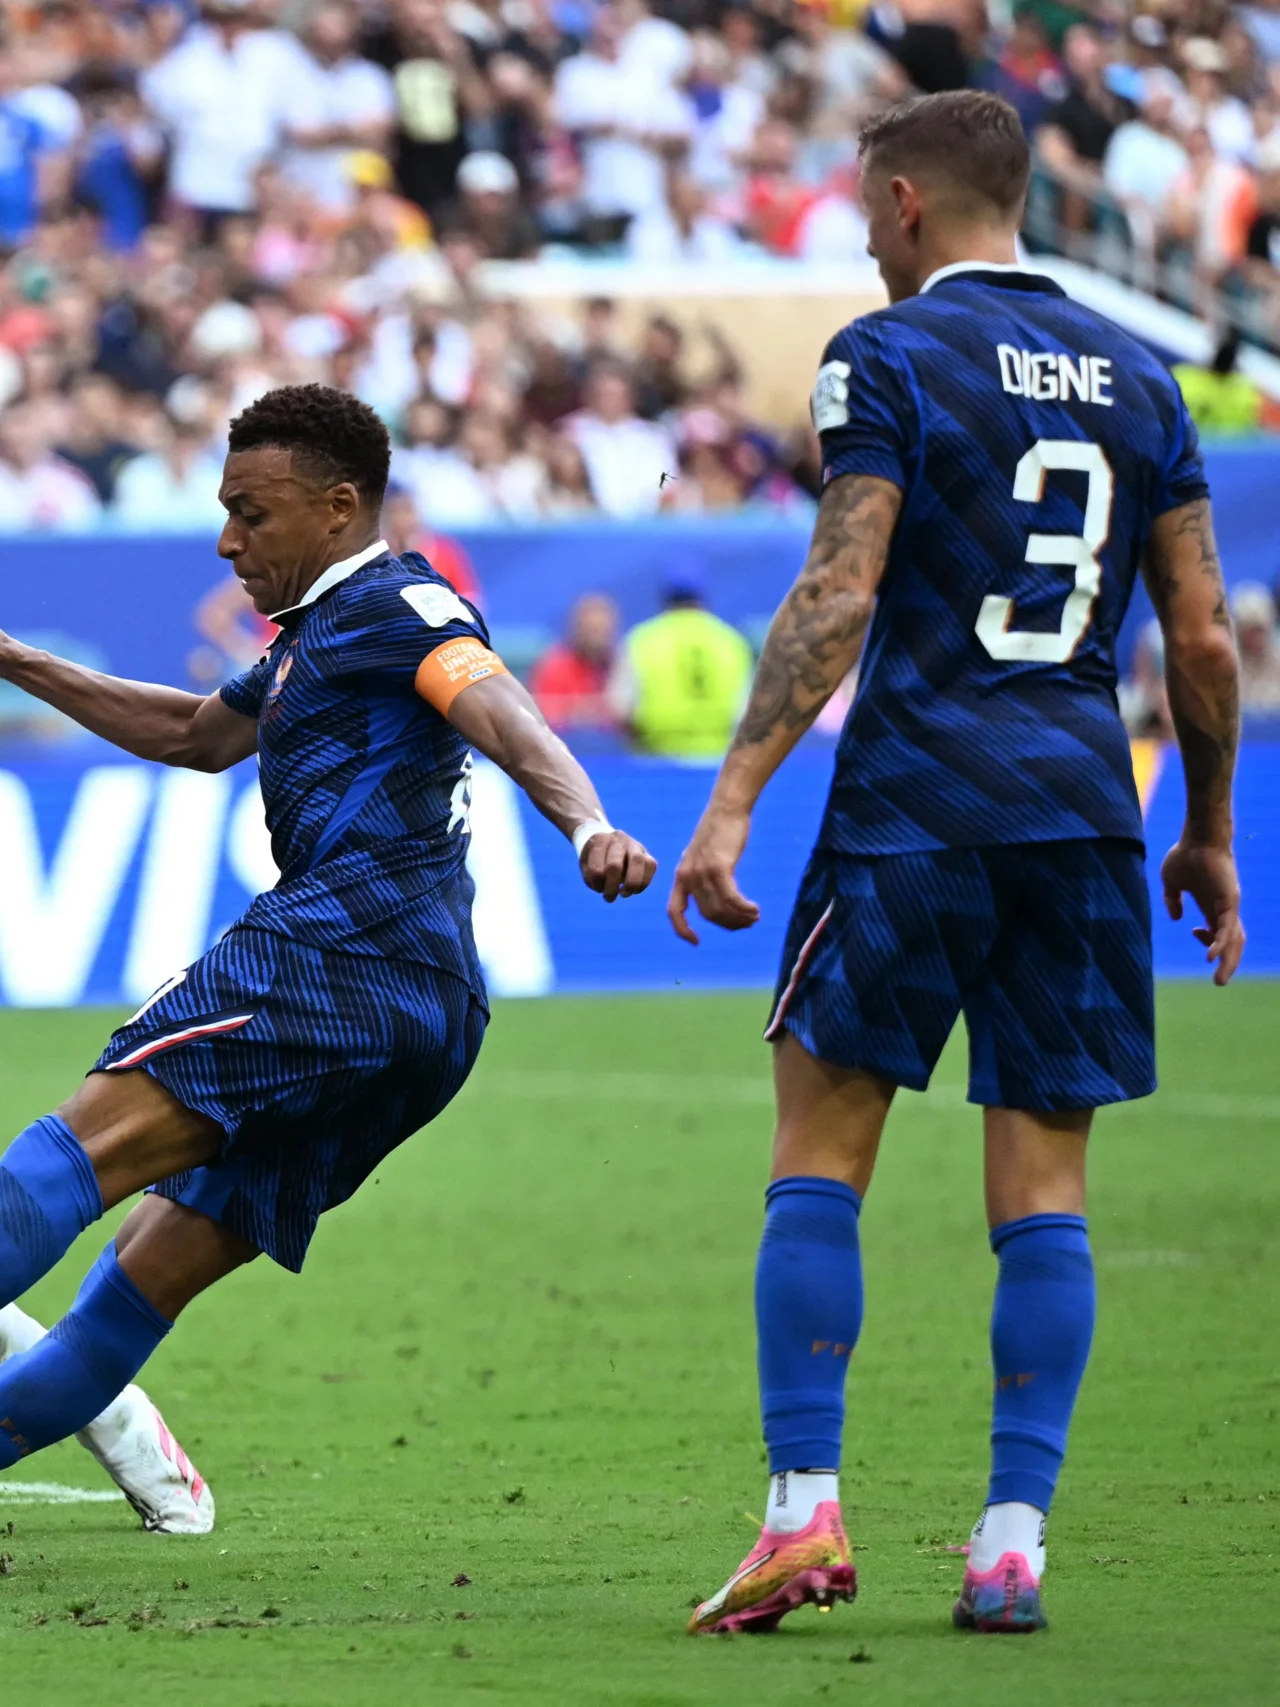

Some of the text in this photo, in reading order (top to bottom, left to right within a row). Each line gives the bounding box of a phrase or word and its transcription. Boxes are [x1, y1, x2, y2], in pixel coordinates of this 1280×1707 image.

[997, 343, 1113, 406] DIGNE
[974, 439, 1115, 663] 3
[436, 642, 486, 662] FOOTBA
